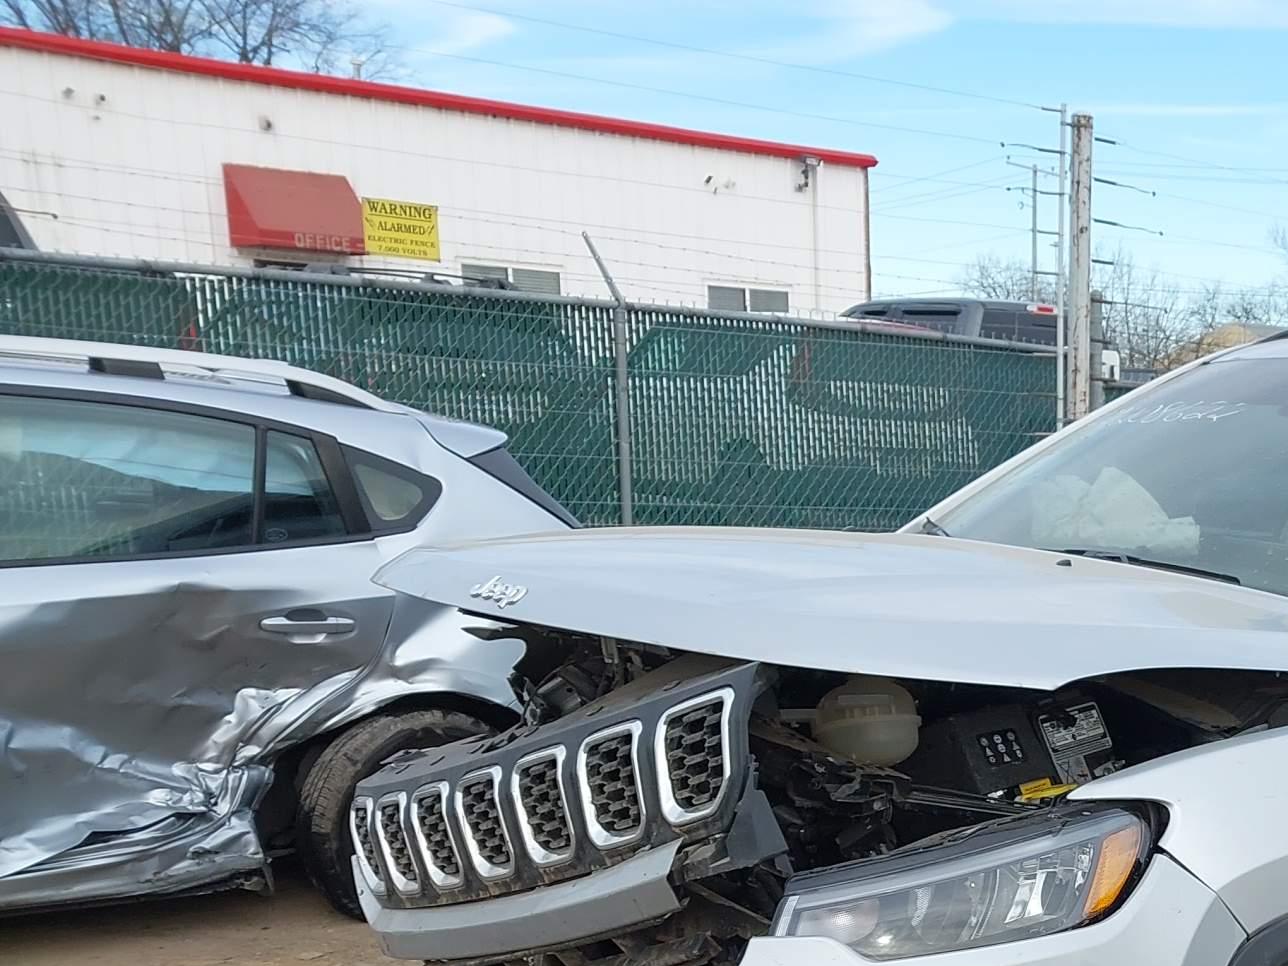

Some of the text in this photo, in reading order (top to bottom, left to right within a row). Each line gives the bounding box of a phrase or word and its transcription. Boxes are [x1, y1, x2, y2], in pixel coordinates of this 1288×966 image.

[367, 201, 432, 219] WARNING
[377, 220, 425, 235] ALARMED
[295, 232, 352, 253] OFFICE
[367, 234, 436, 248] ELECTRIC FENCE
[401, 247, 428, 257] VOLTS
[469, 575, 529, 610] Jeep
